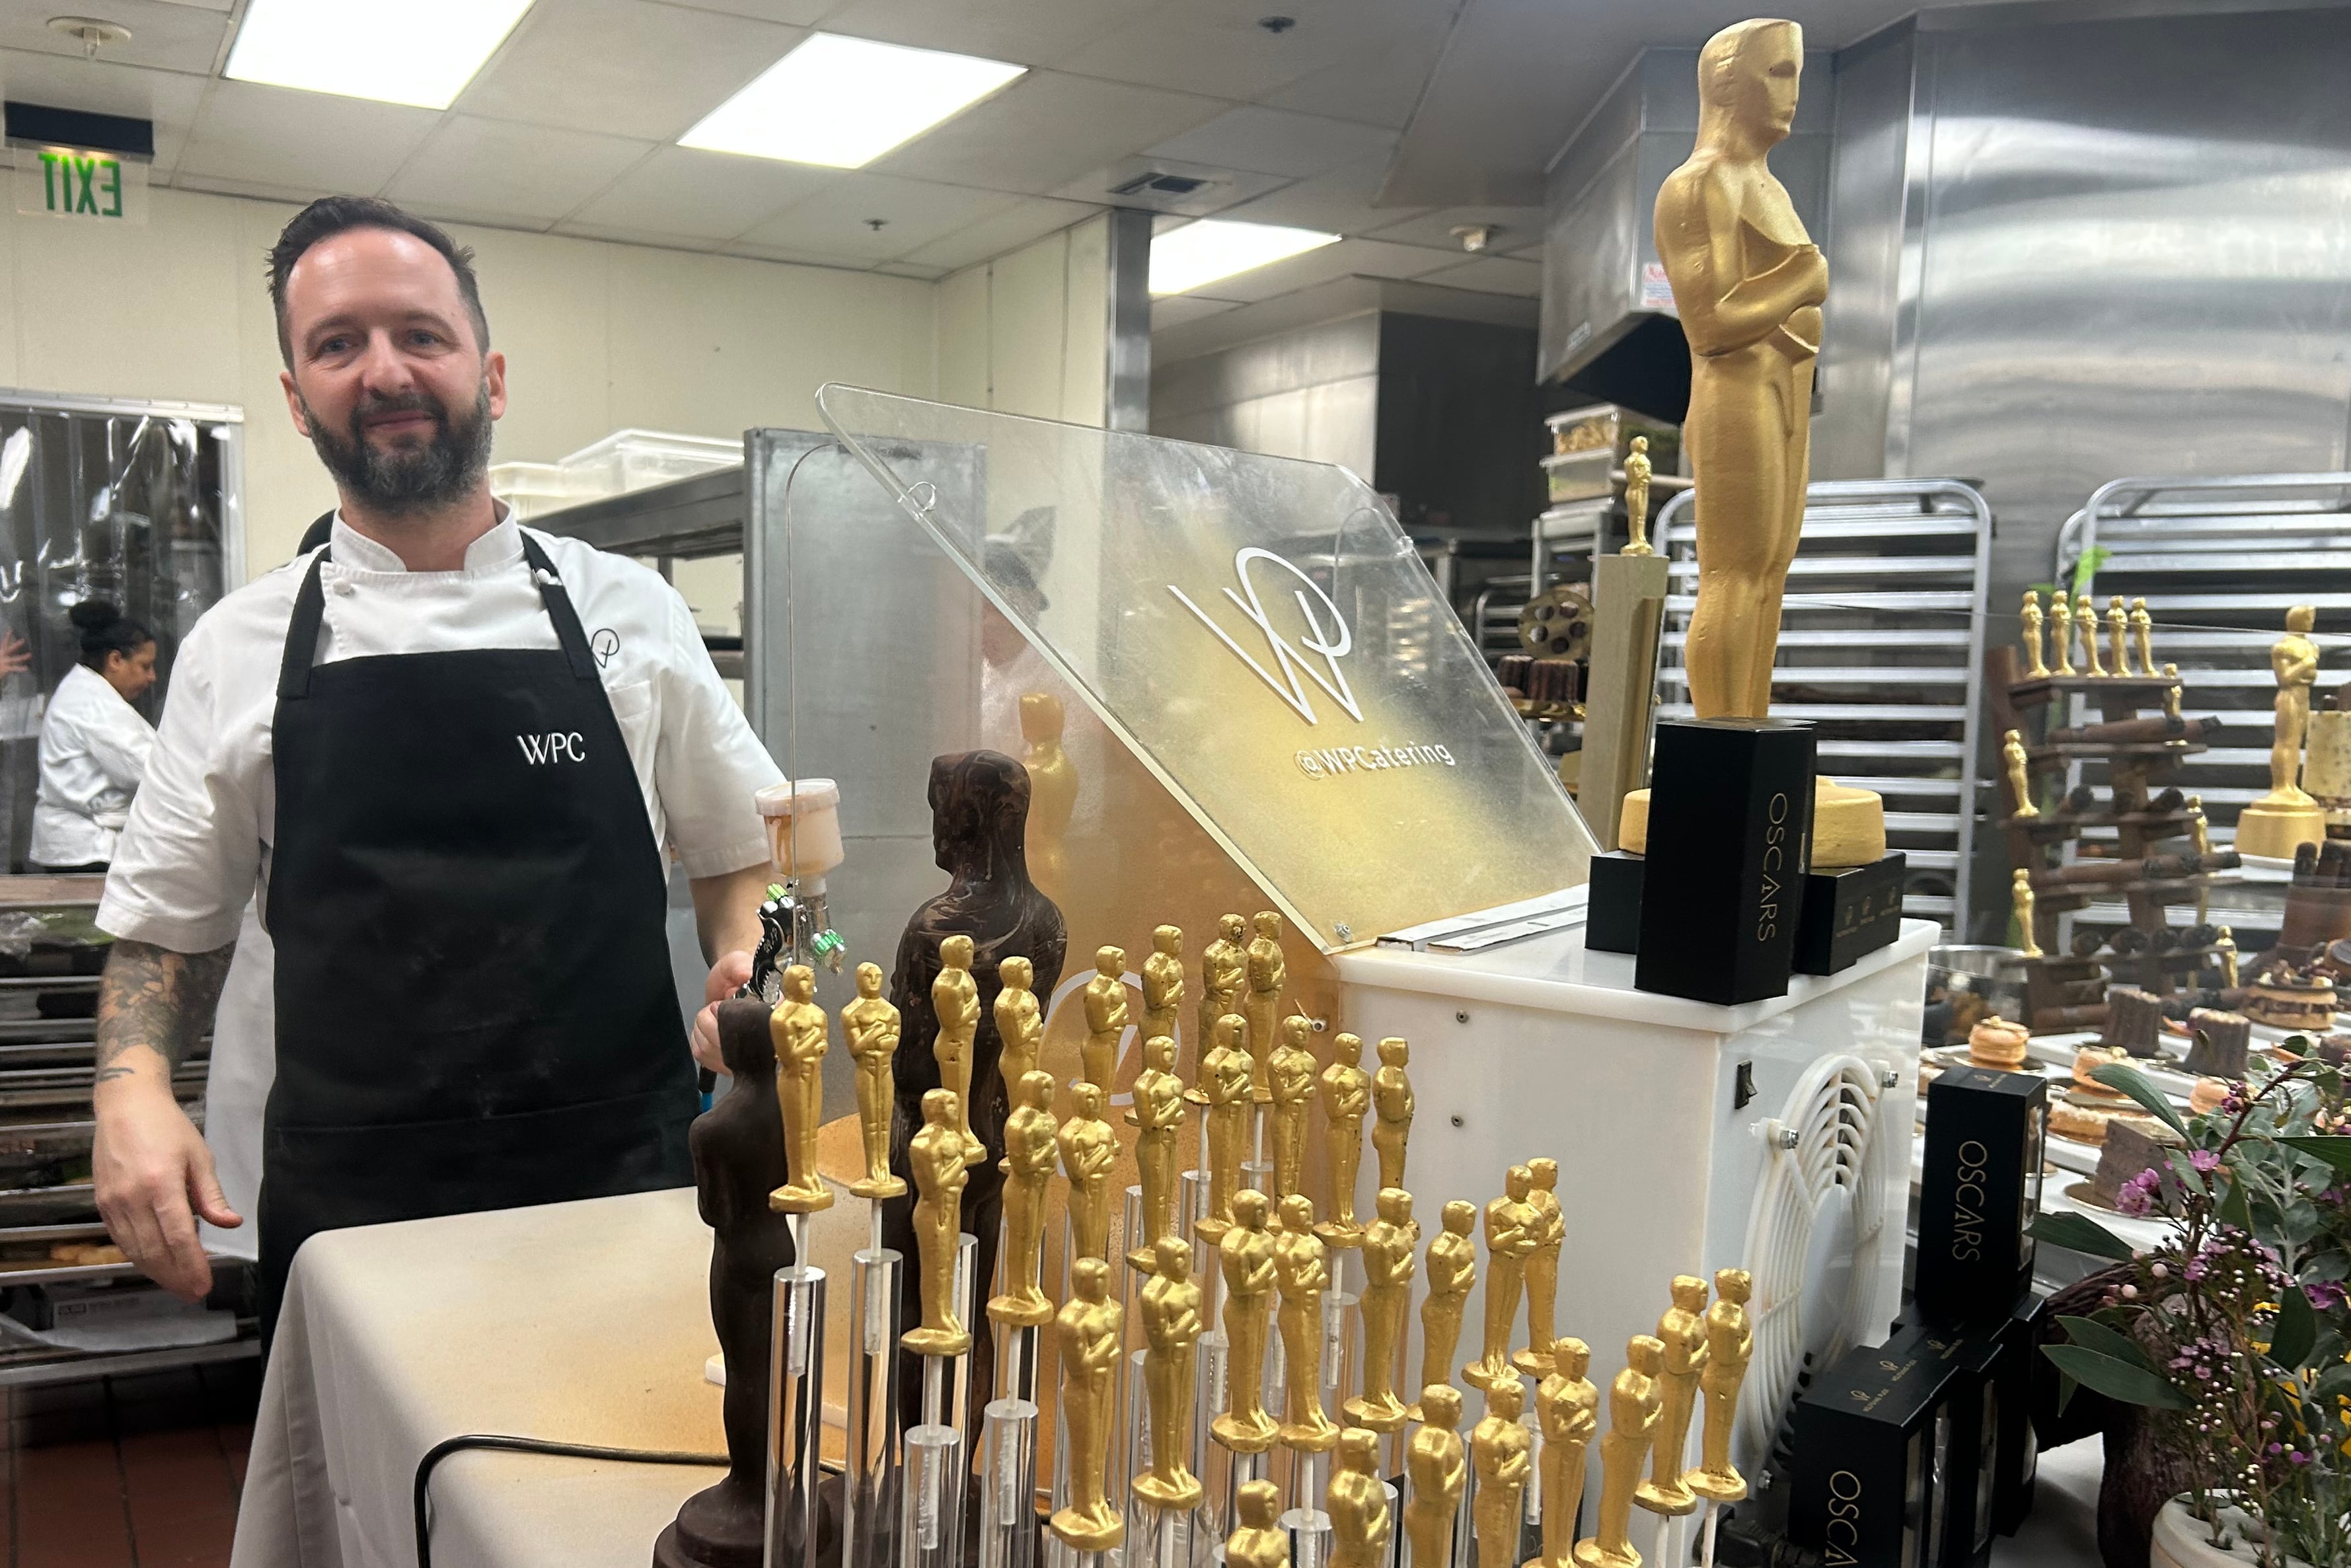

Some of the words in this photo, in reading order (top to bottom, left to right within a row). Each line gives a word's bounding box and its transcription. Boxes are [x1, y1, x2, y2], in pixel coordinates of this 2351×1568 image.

[517, 732, 585, 765] WPC
[1296, 740, 1456, 778] @WPCatering
[1758, 793, 1787, 942] OSCARS
[1952, 1140, 1988, 1261] OSCARS
